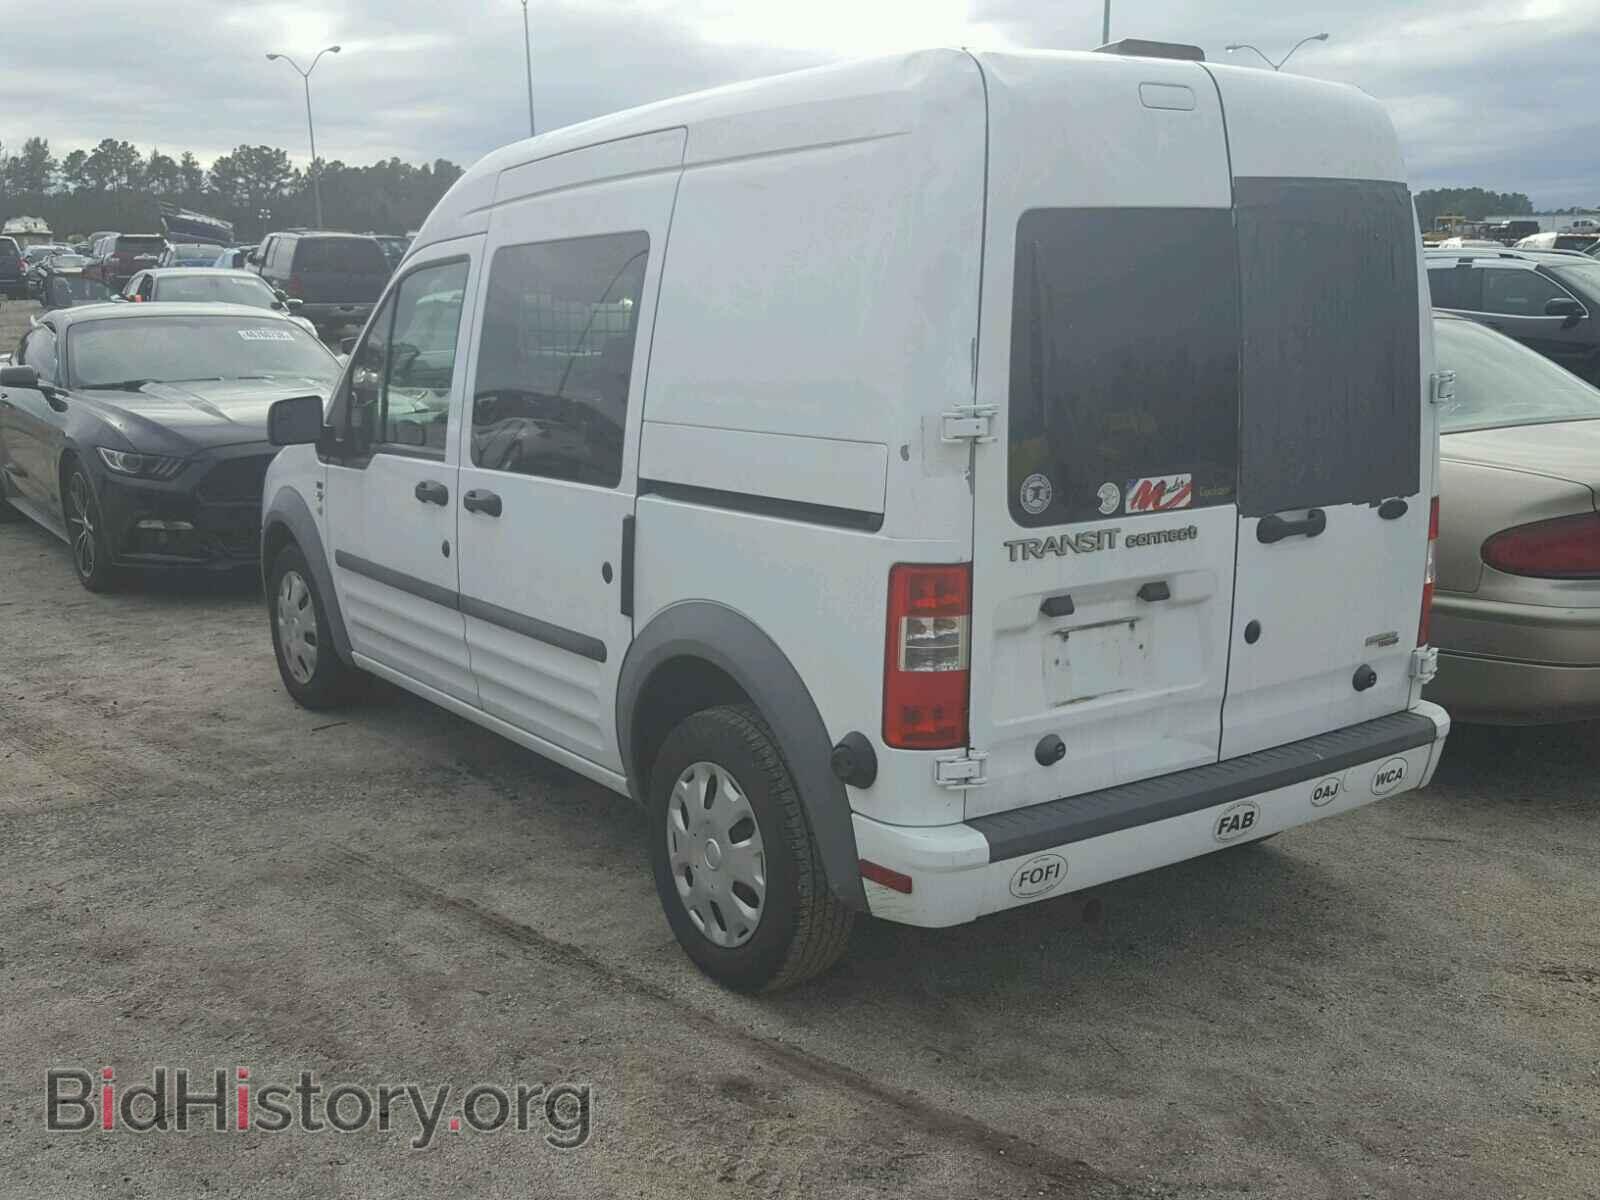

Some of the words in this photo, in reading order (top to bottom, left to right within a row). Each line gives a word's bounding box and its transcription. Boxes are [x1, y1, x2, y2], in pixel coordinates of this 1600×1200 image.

[1003, 528, 1121, 562] TRANSIT
[1125, 524, 1198, 548] connect
[1375, 767, 1404, 787] WCA
[1313, 783, 1339, 801] OAJ
[1217, 811, 1255, 835] FAB
[1018, 863, 1060, 887] FOFI
